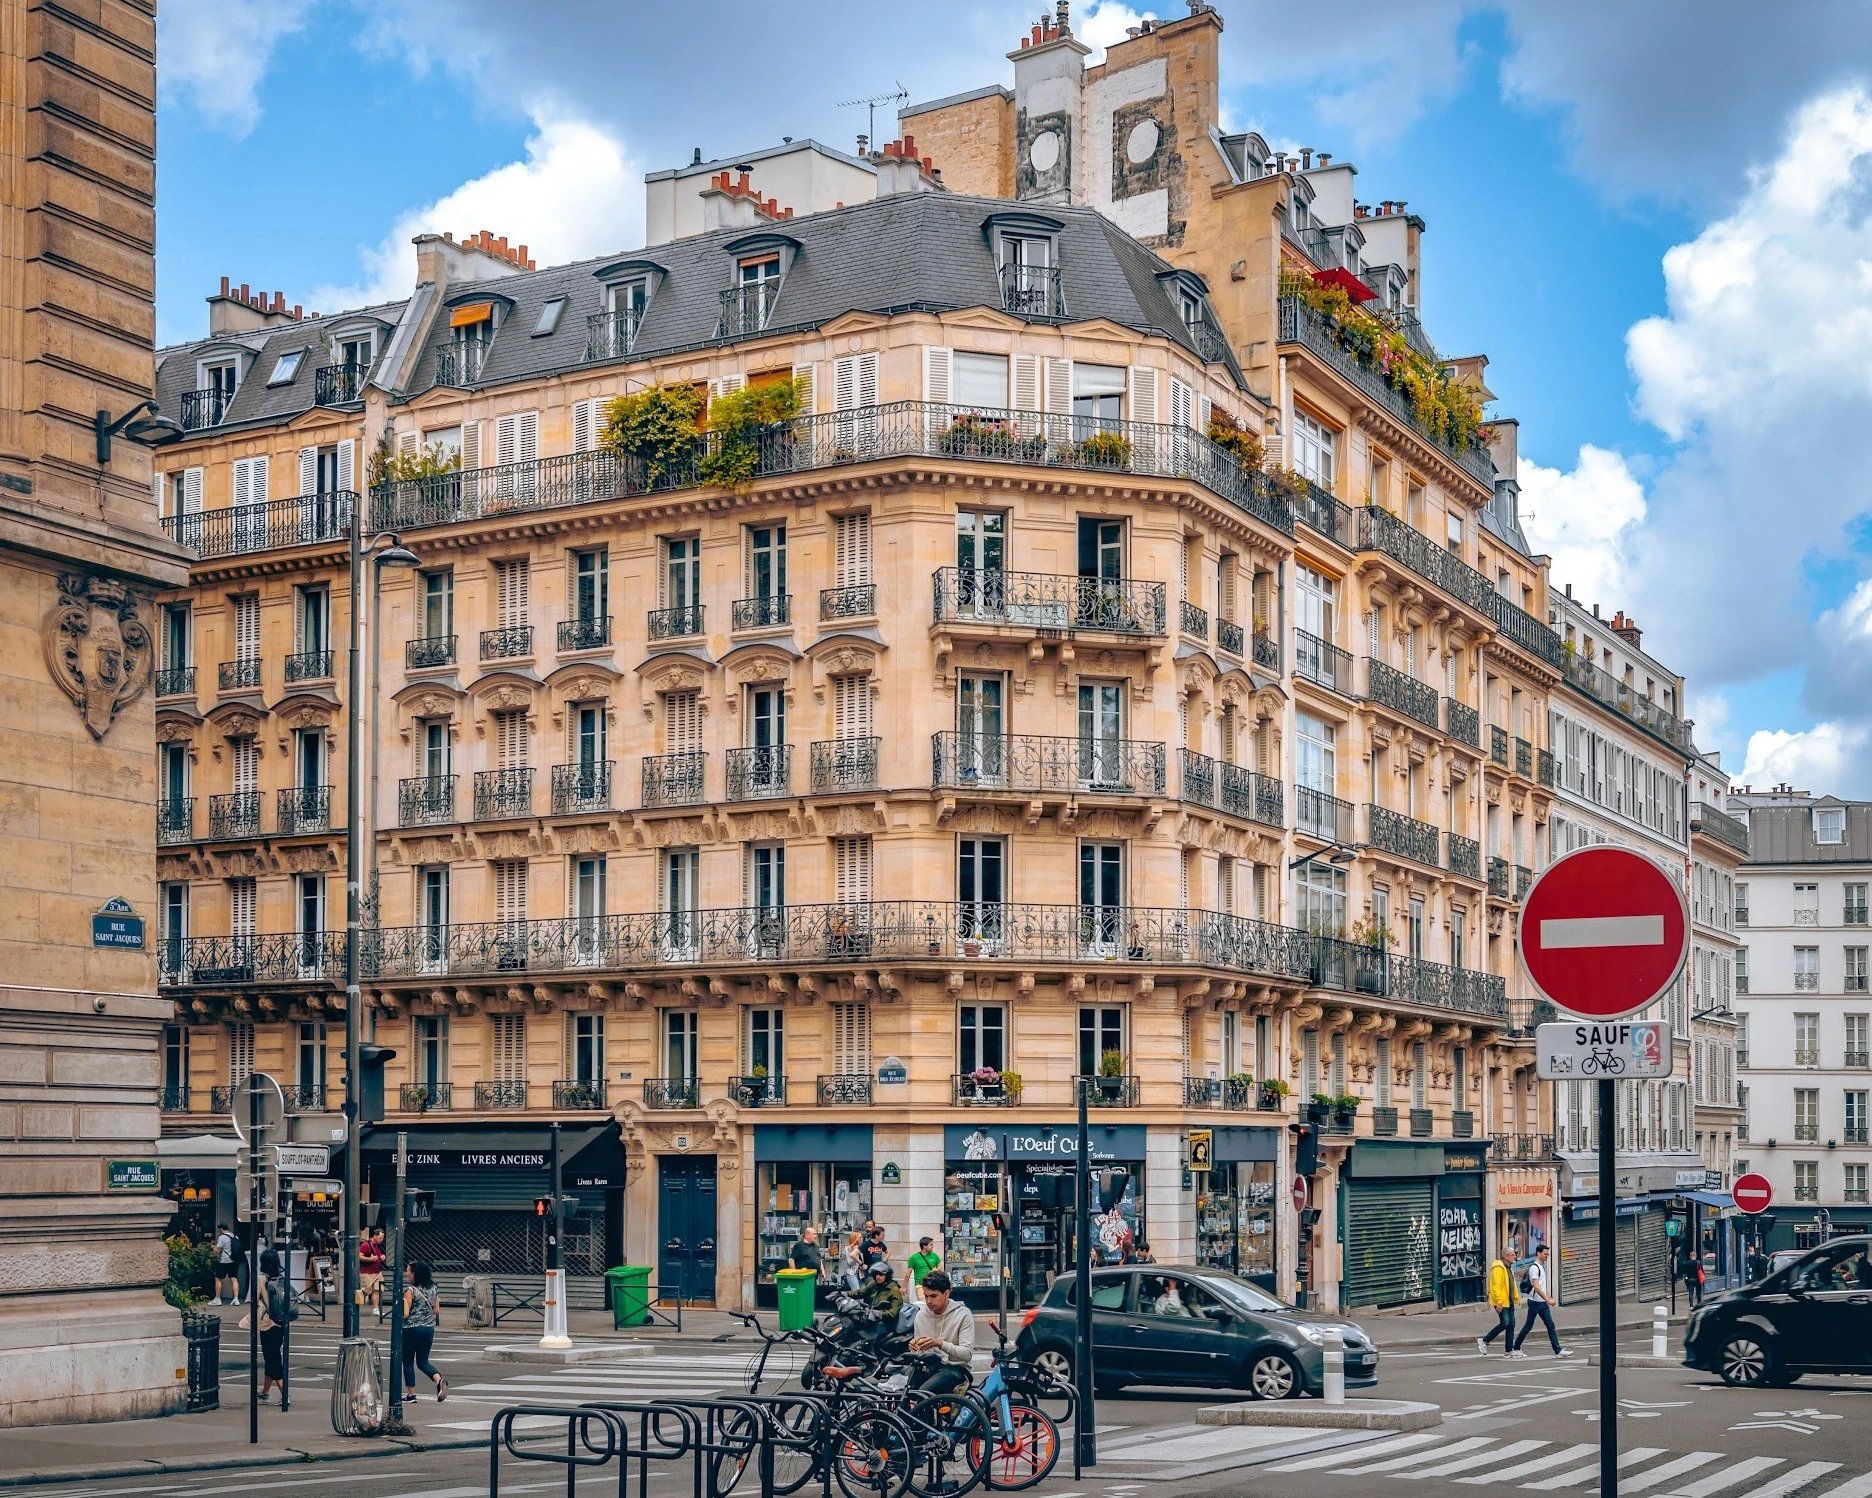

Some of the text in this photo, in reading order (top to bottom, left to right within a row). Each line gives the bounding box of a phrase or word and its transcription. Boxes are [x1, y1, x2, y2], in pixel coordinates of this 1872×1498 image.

[111, 923, 125, 931] RUE
[95, 933, 141, 944] SAINT JACQUES
[1575, 1026, 1630, 1045] SAUF
[1013, 1134, 1094, 1154] L'Oeuf Cue
[392, 1154, 440, 1164] EIC ZINK
[461, 1154, 544, 1165] LIVRES ANCIENS
[127, 1166, 141, 1174] RUE
[130, 1174, 154, 1182] JACQUES
[1499, 1183, 1545, 1197] Au Vieux Campeur
